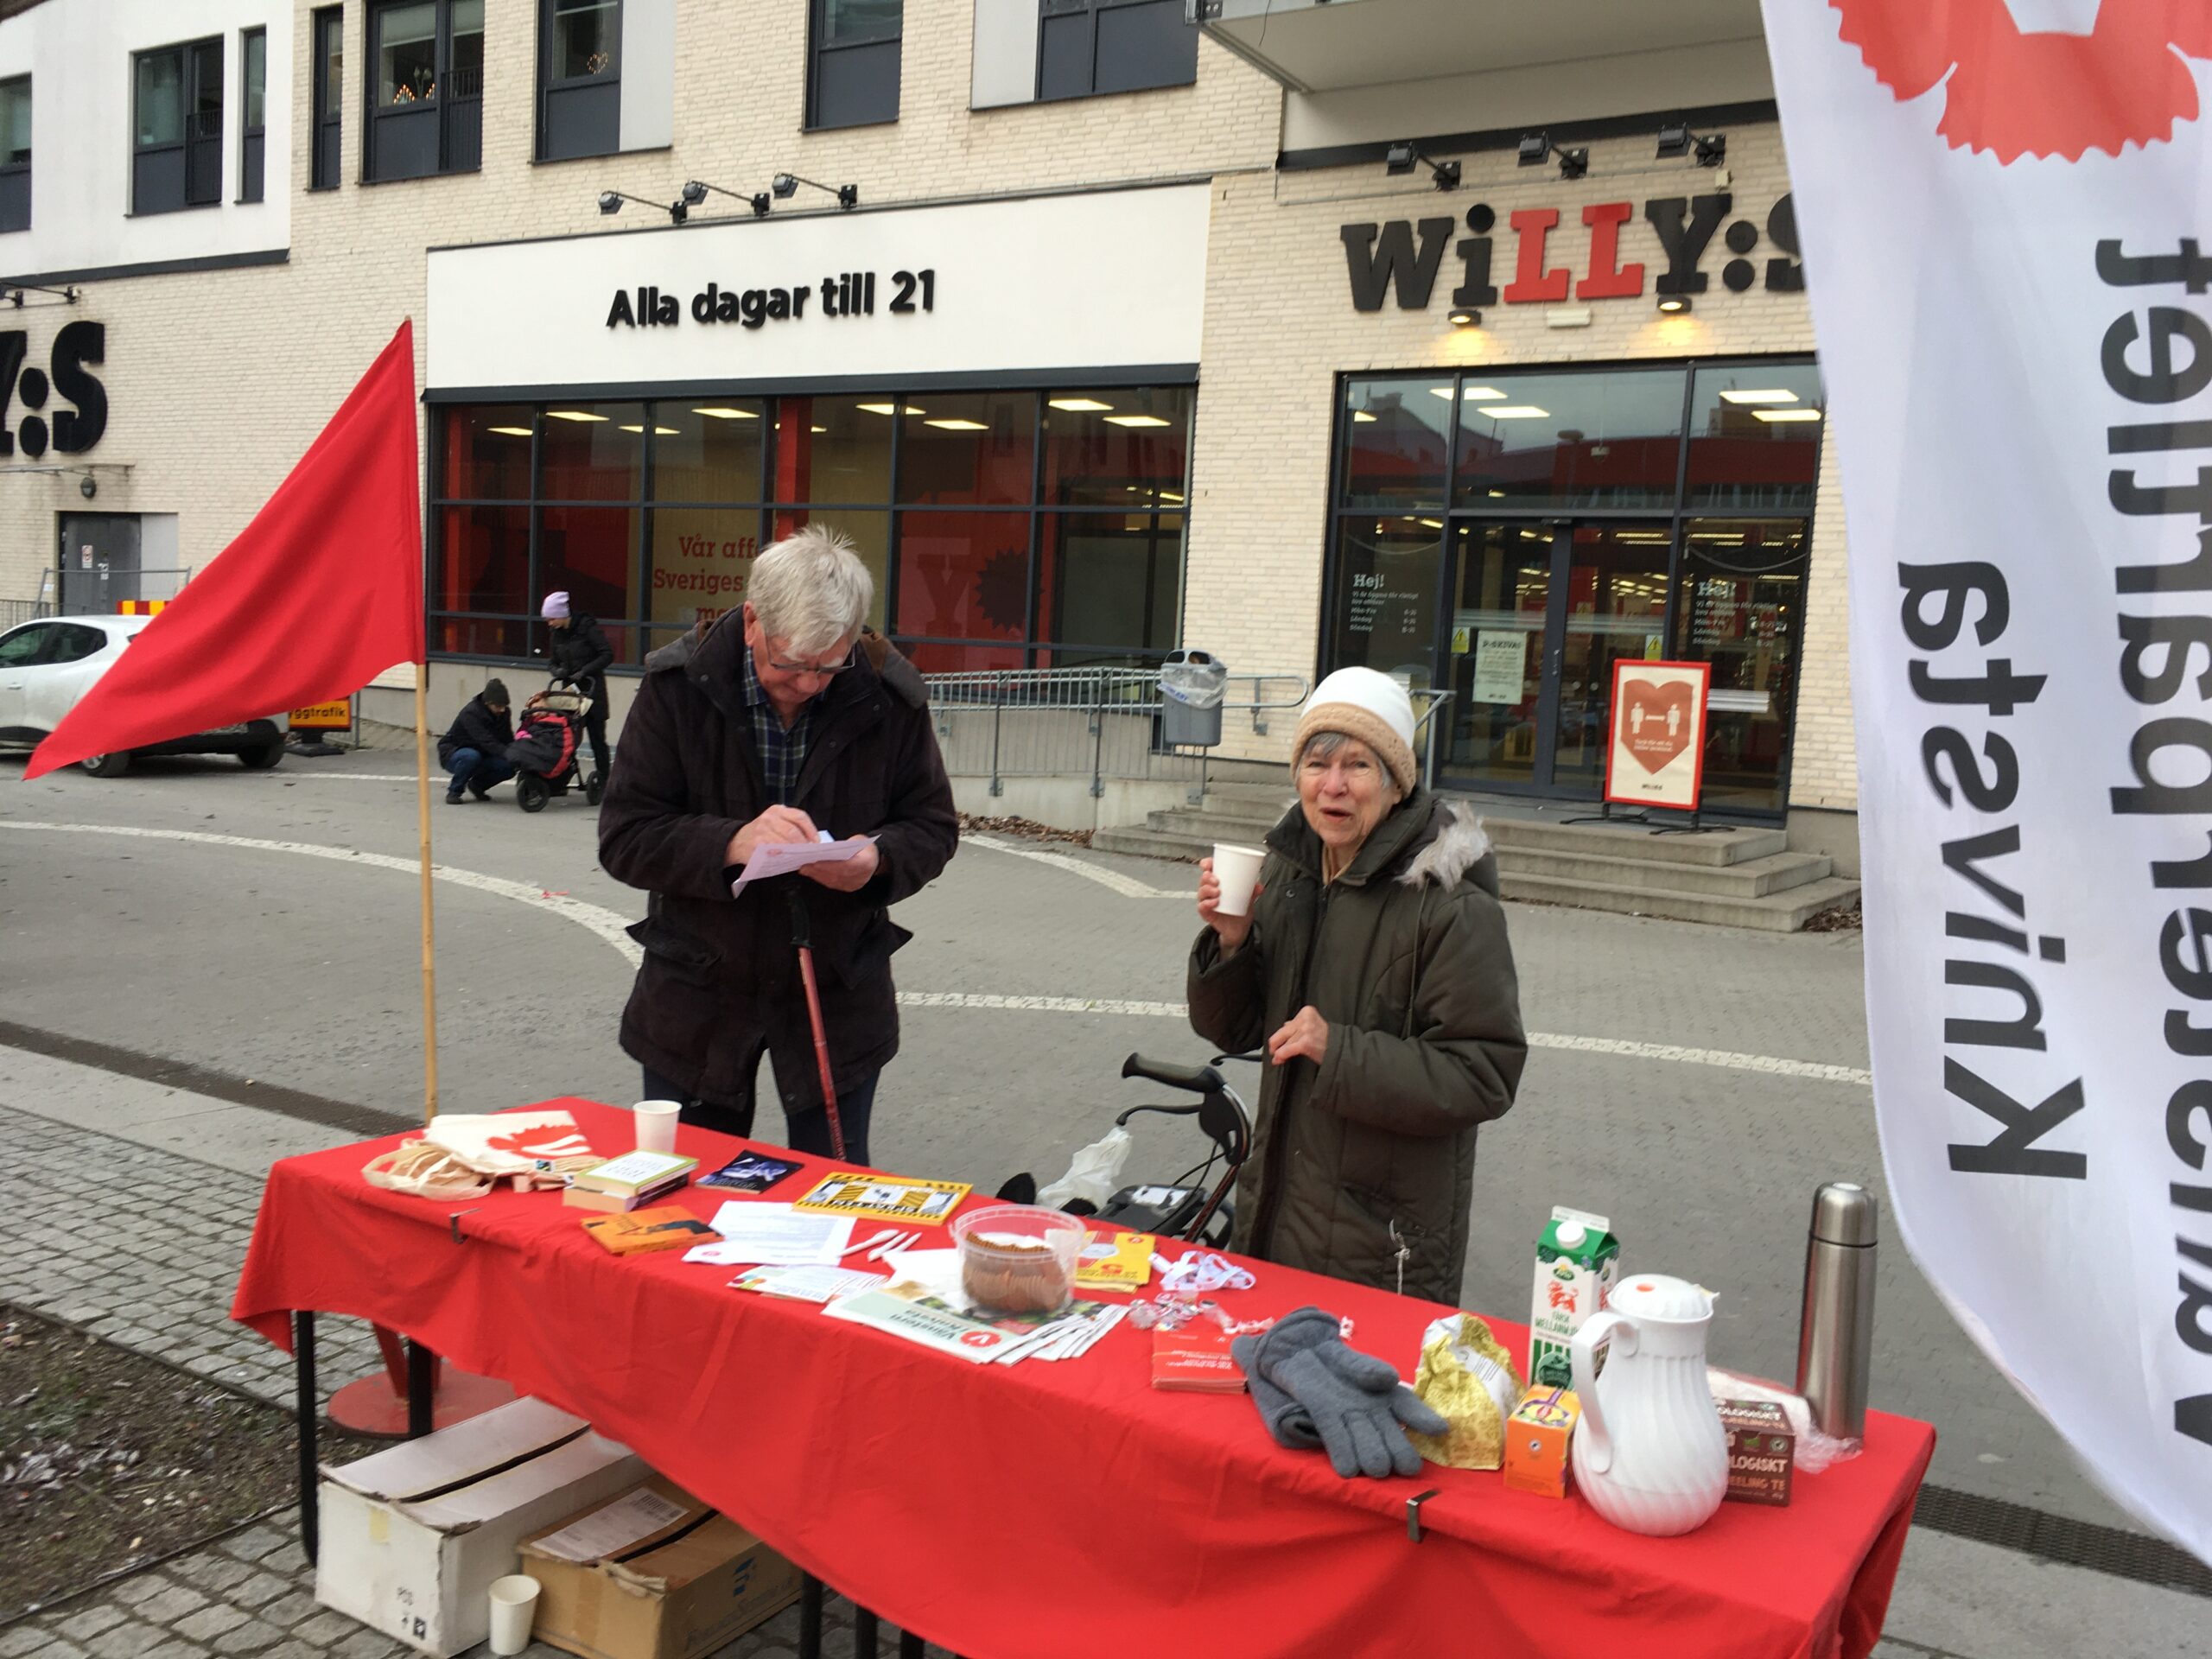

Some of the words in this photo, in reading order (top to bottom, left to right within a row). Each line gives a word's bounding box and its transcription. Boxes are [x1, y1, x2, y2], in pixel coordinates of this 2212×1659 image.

[606, 286, 680, 328] Alla
[691, 283, 810, 330] dagar
[820, 272, 875, 316] till
[889, 270, 936, 313] 21
[678, 533, 715, 558] Vår
[653, 569, 744, 595] Sveriges
[1353, 574, 1385, 590] Hej!
[289, 706, 346, 720] ggtrafik
[1728, 1455, 1789, 1473] LOGISKT
